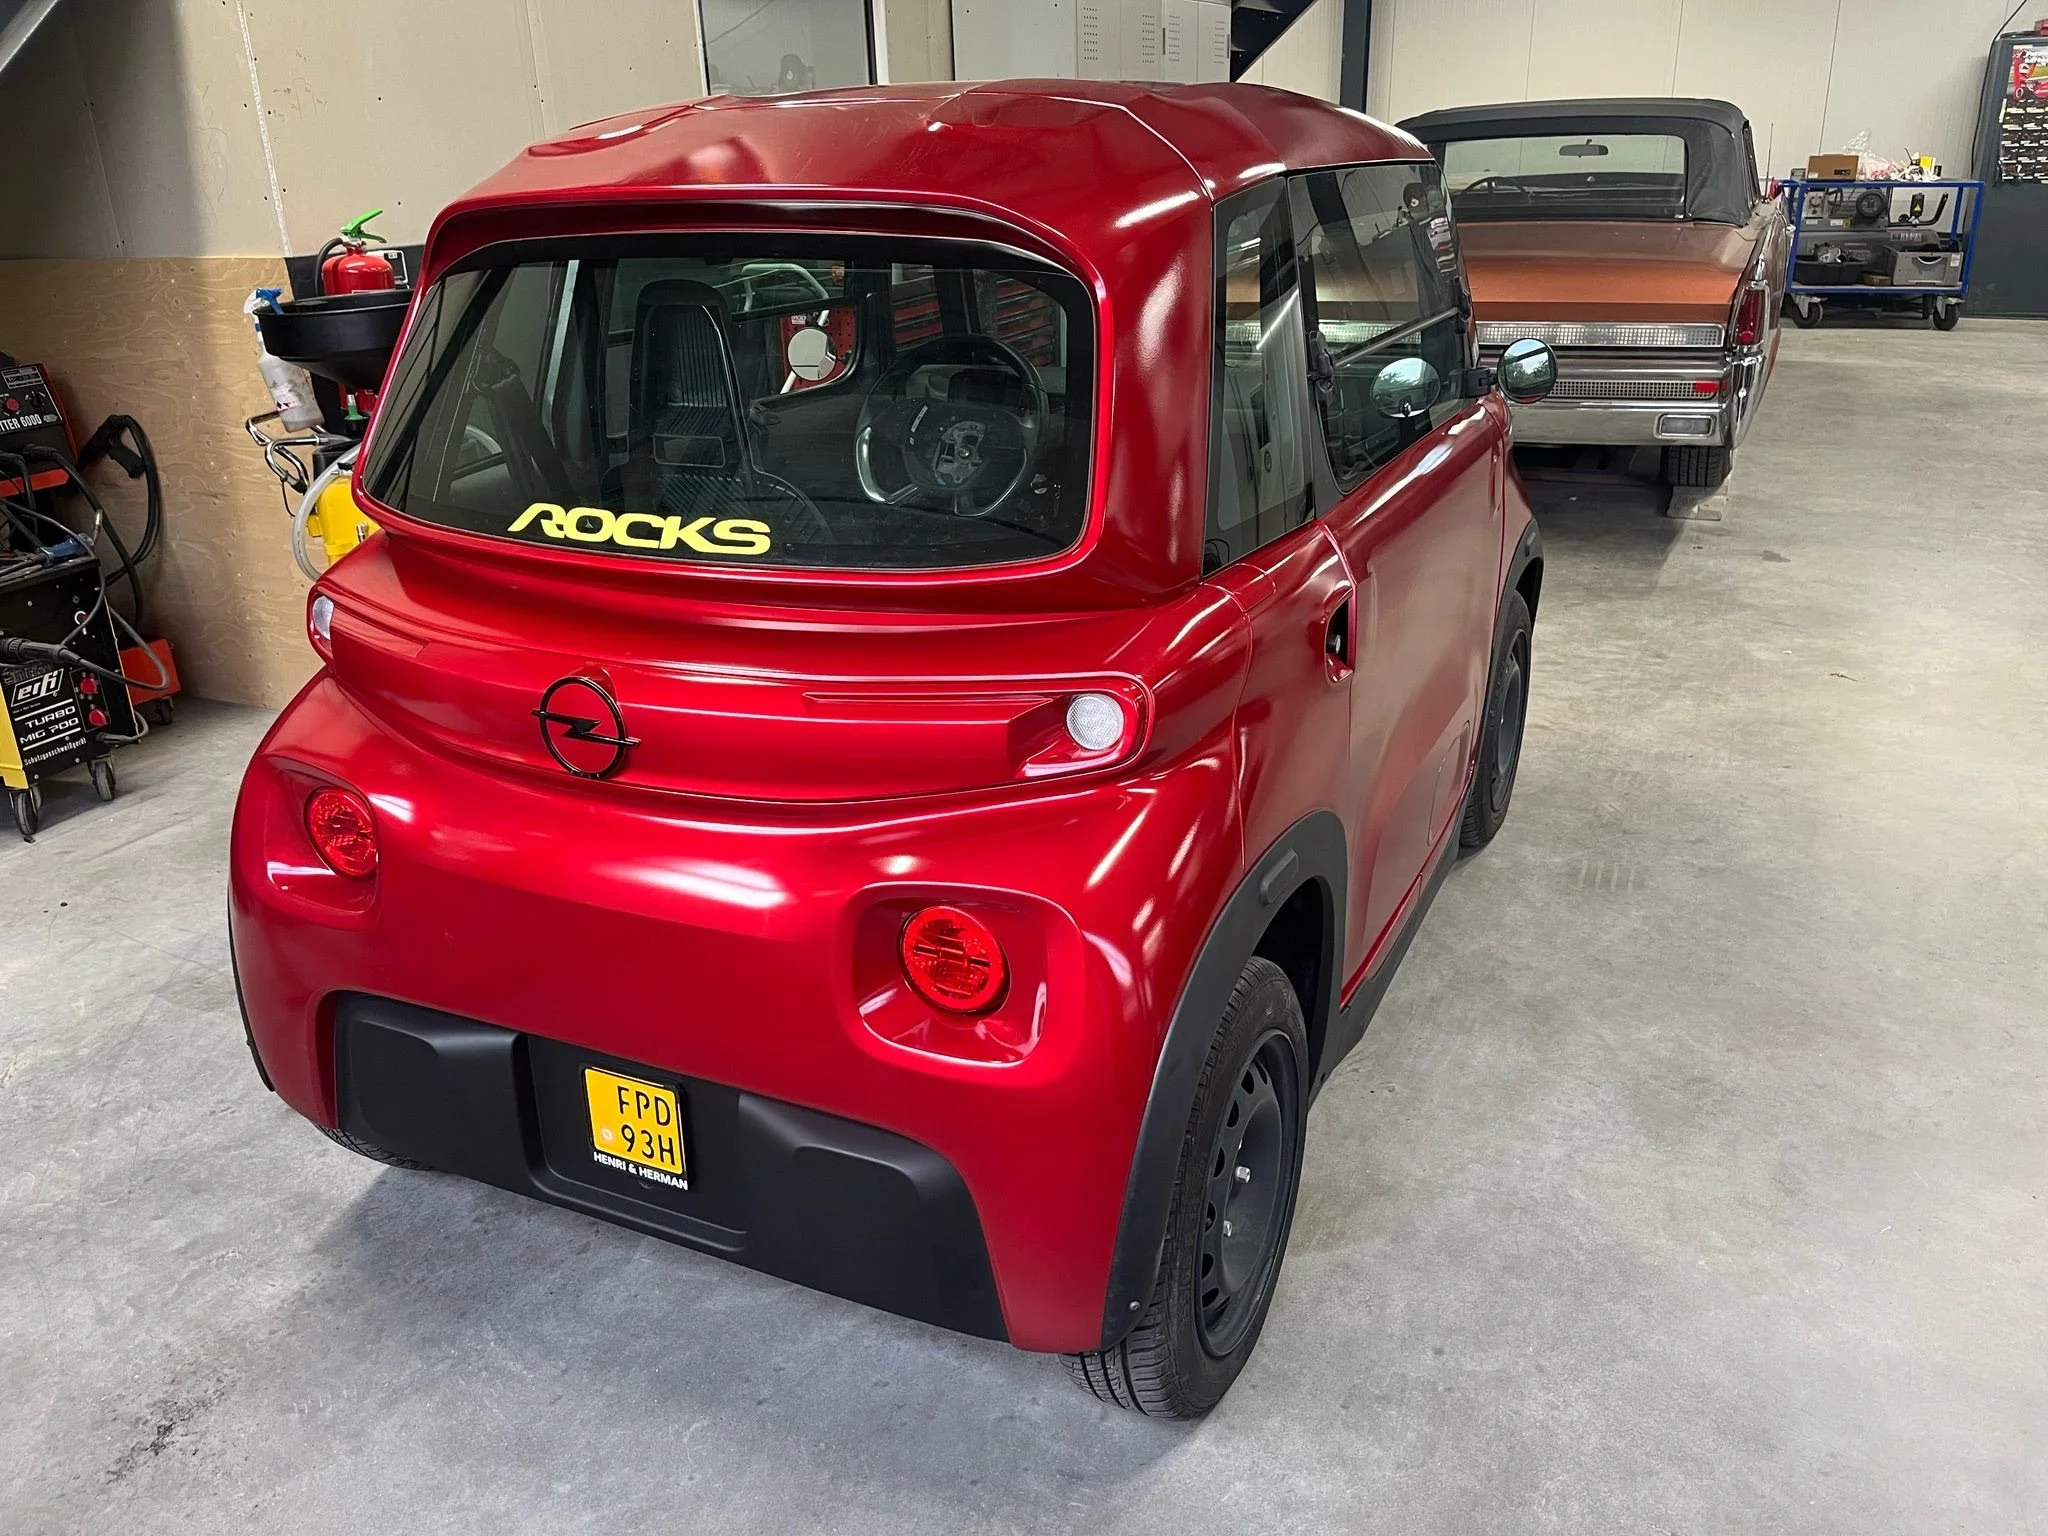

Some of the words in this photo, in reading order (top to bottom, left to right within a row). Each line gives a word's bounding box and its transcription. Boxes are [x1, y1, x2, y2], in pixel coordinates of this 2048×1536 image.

[0, 418, 21, 431] TTER
[20, 413, 42, 427] 6000
[507, 502, 771, 555] ROCKS
[20, 729, 46, 744] MIG
[48, 717, 79, 733] 700
[25, 706, 76, 728] TURBO
[617, 1085, 671, 1126] FPD
[621, 1124, 676, 1166] 93H
[593, 1151, 627, 1171] HENRI
[628, 1163, 638, 1175] &
[638, 1166, 689, 1191] HERMAN
